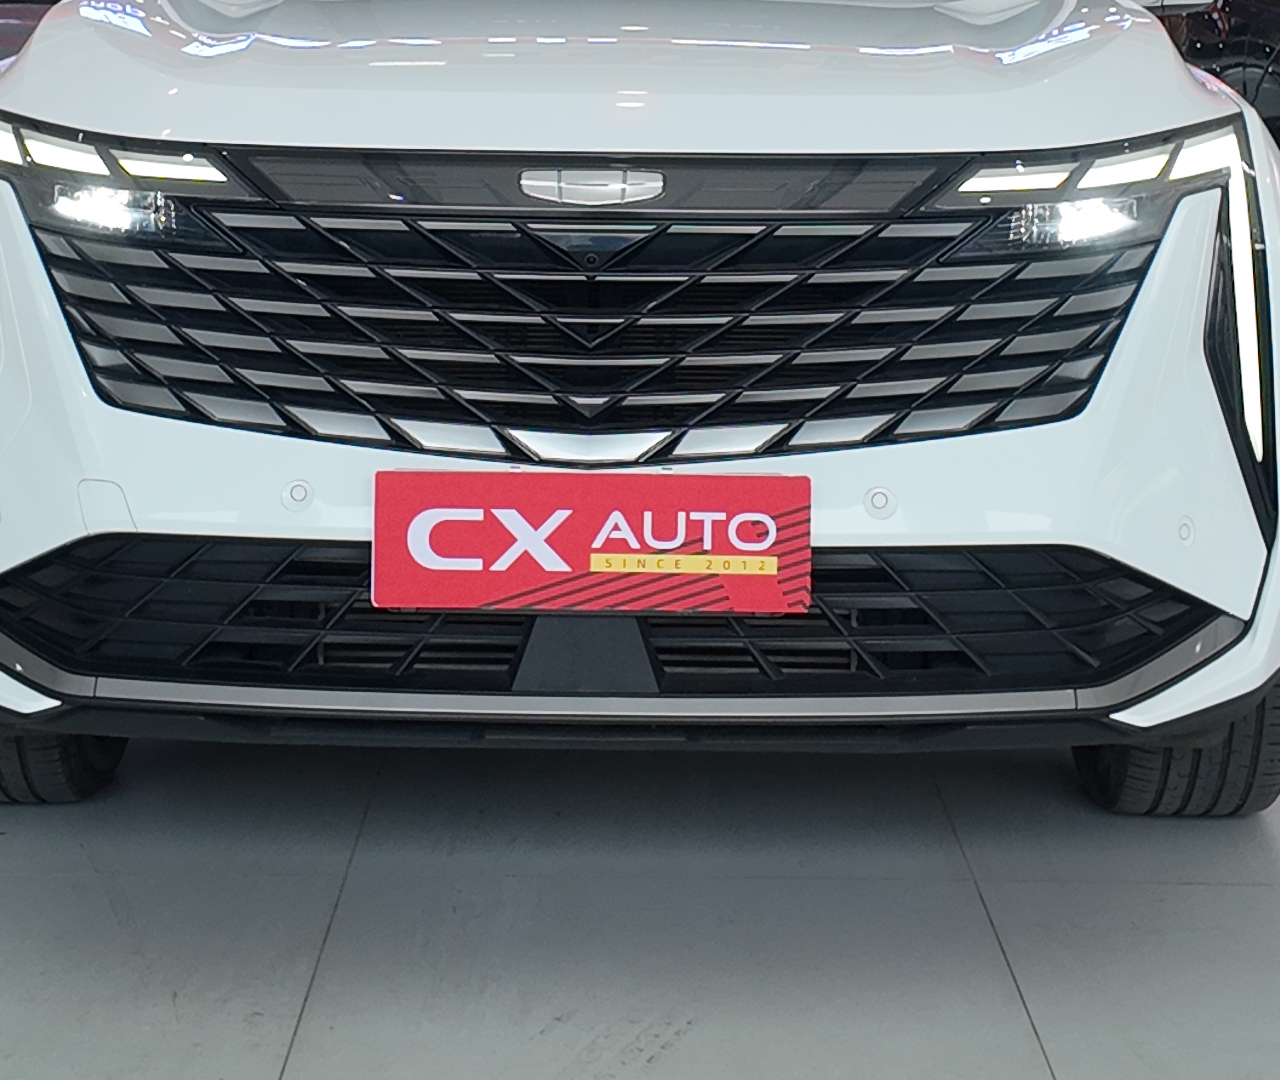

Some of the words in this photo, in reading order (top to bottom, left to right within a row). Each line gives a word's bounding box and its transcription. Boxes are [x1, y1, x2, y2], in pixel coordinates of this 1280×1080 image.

[406, 507, 573, 572] CX
[591, 510, 777, 551] AUTO
[605, 557, 683, 570] SINCE
[705, 559, 767, 572] 2012
